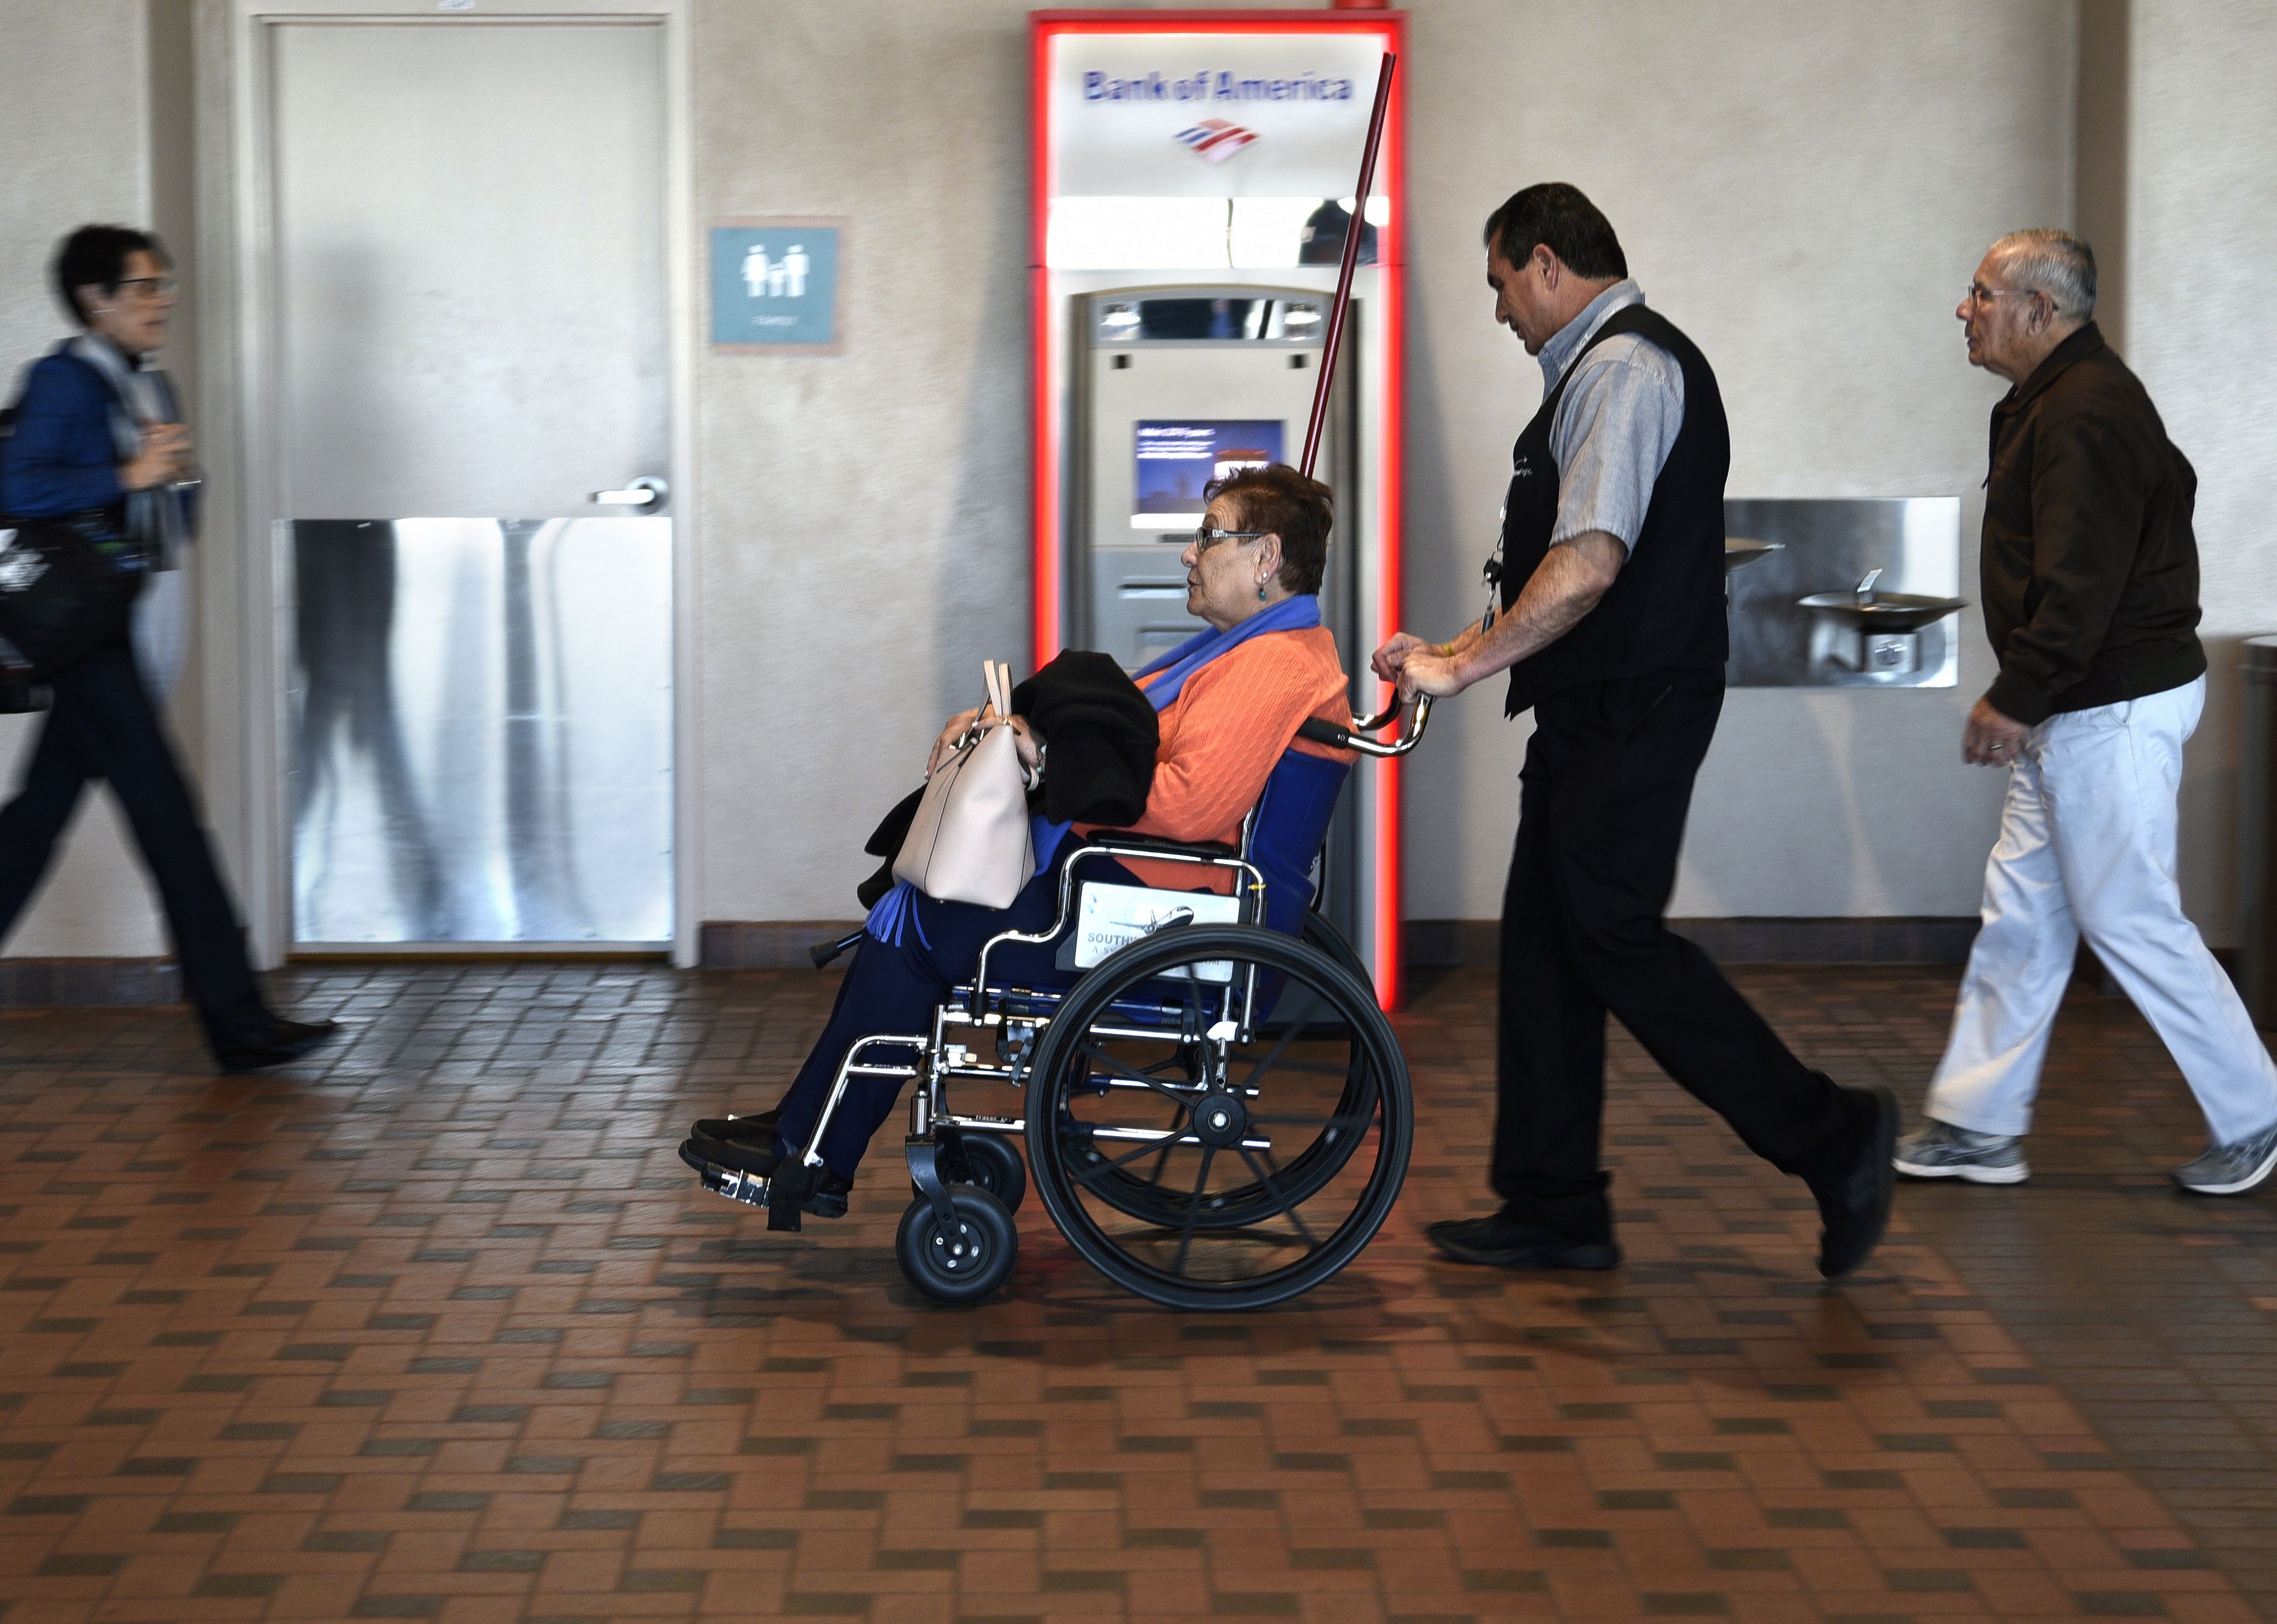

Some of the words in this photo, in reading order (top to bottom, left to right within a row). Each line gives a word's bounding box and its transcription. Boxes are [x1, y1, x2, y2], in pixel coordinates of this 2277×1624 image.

[1083, 70, 1168, 101] Bank
[1173, 69, 1210, 100] of
[1215, 70, 1352, 101] America
